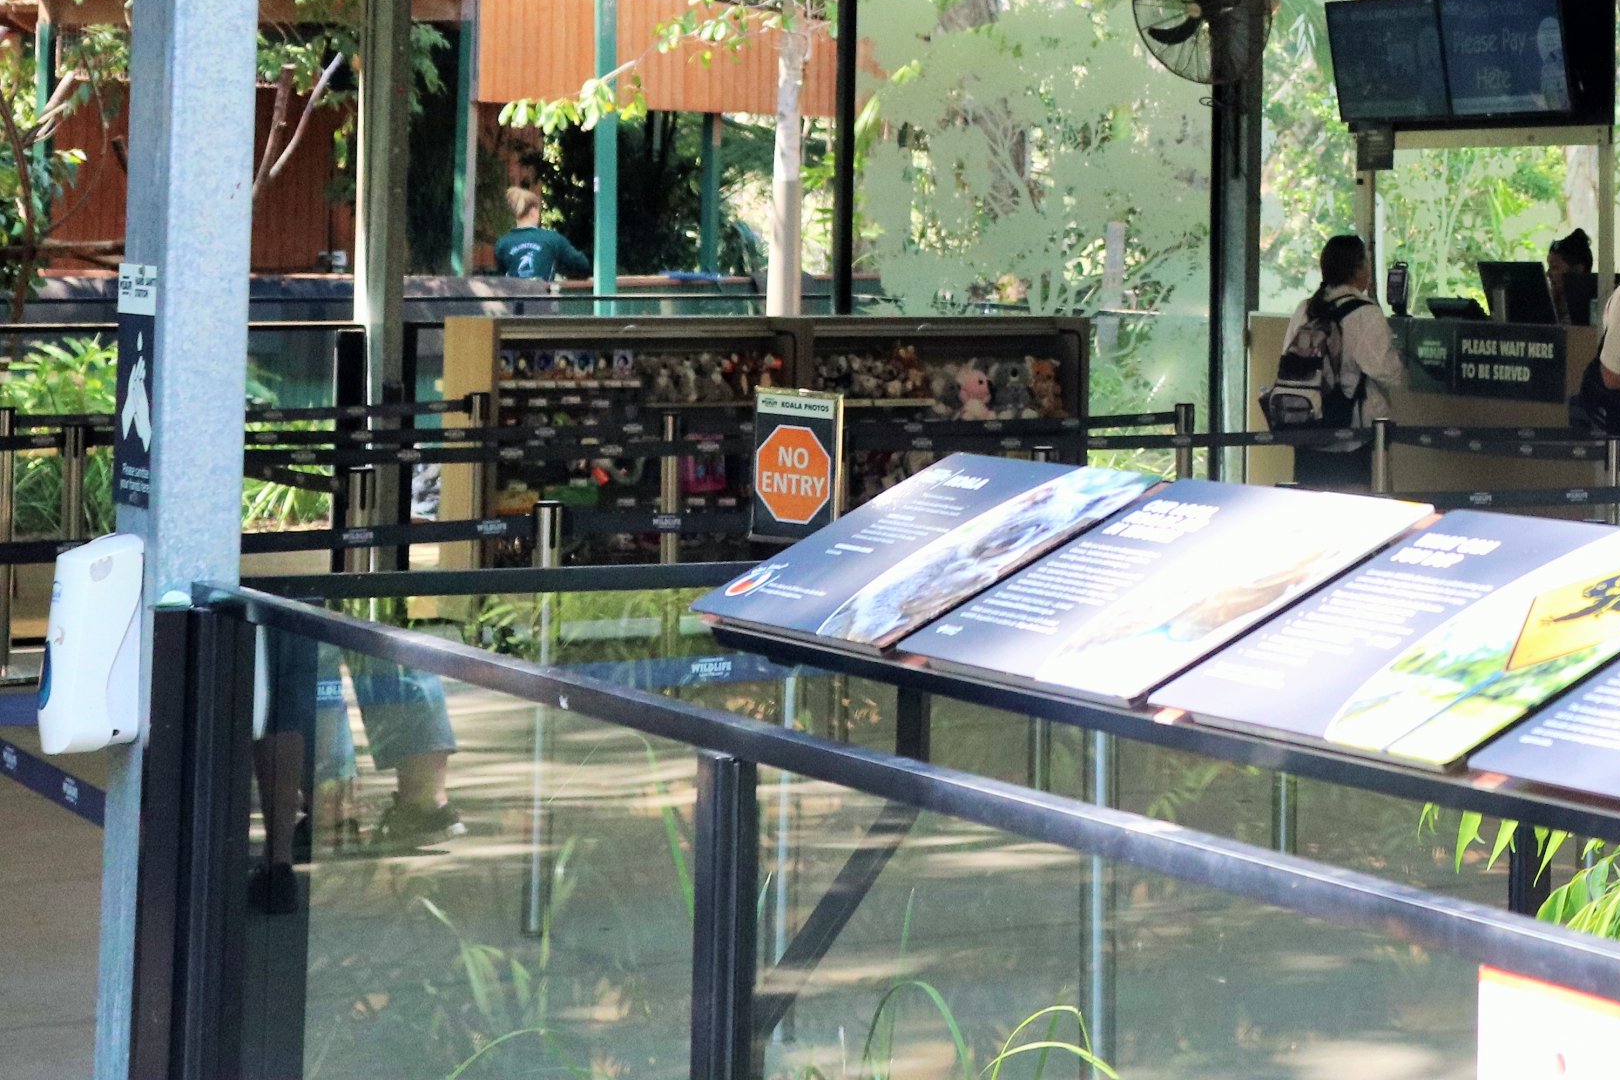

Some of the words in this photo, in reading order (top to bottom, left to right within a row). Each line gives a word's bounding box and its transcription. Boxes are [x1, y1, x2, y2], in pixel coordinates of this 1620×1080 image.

[1453, 31, 1498, 55] Please
[1502, 28, 1527, 56] Pay
[1477, 67, 1512, 89] Here
[1461, 339, 1498, 356] PLEASE
[1499, 340, 1525, 357] WAIT
[1528, 342, 1554, 359] HERE
[1461, 363, 1475, 379] TO
[1478, 364, 1490, 380] BE
[1493, 365, 1531, 382] SERVED
[781, 401, 802, 410] KOALA
[804, 403, 830, 413] PHOTOS
[778, 446, 809, 469] NO
[762, 471, 826, 498] ENTRY
[691, 661, 731, 673] WILDLIFE
